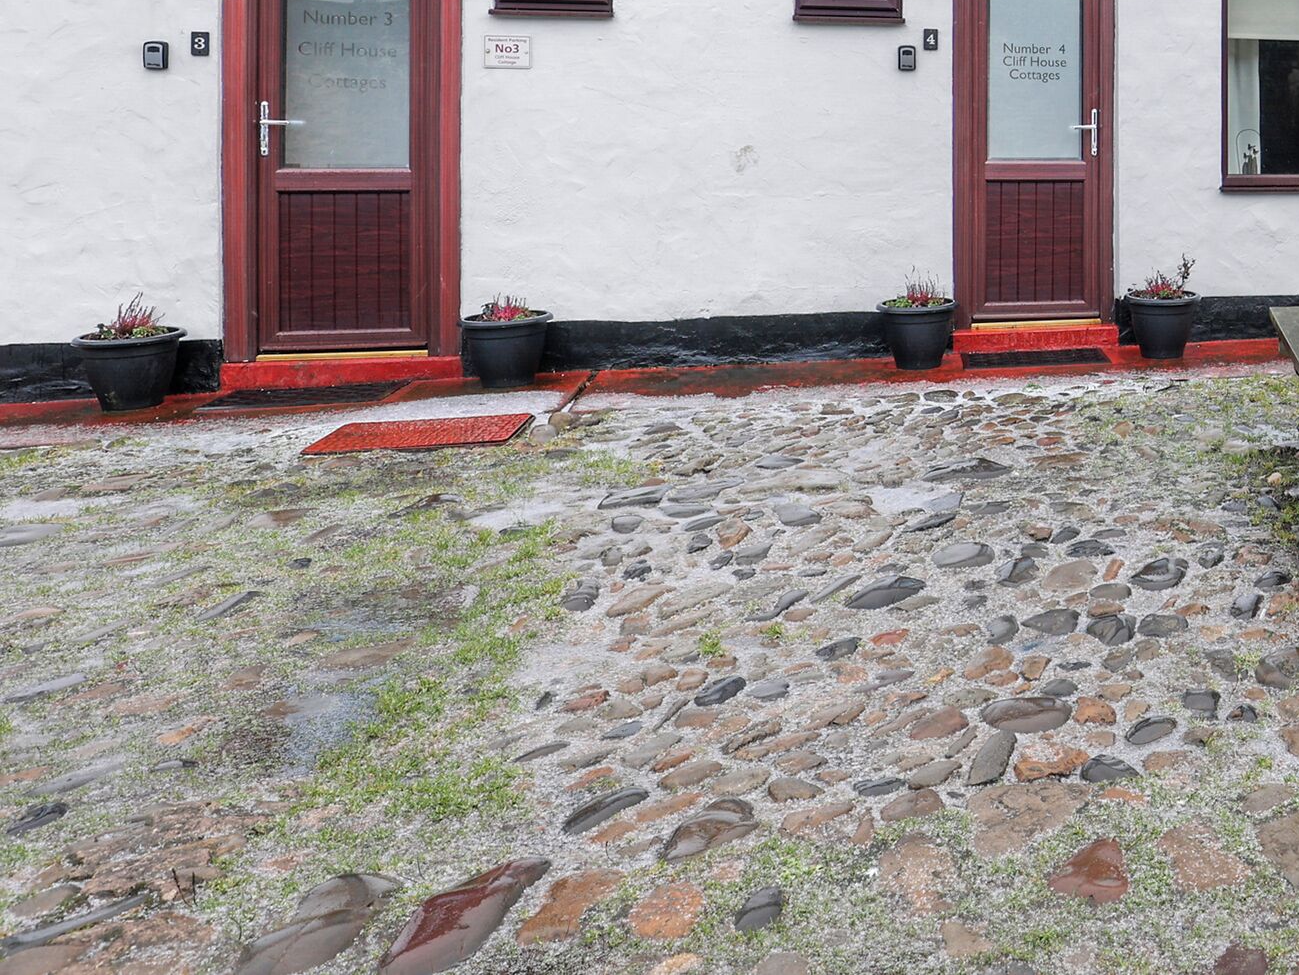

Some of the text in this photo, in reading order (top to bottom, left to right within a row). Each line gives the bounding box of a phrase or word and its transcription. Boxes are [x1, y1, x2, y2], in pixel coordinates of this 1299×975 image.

[303, 9, 393, 27] Number 3
[193, 37, 206, 50] 3
[926, 33, 936, 45] 4
[298, 41, 397, 58] Cliff House
[495, 43, 520, 54] No3
[1003, 42, 1066, 55] Number 4
[1002, 55, 1067, 68] Cliff House
[1009, 68, 1061, 84] Cottages
[308, 73, 387, 94] Cottages
